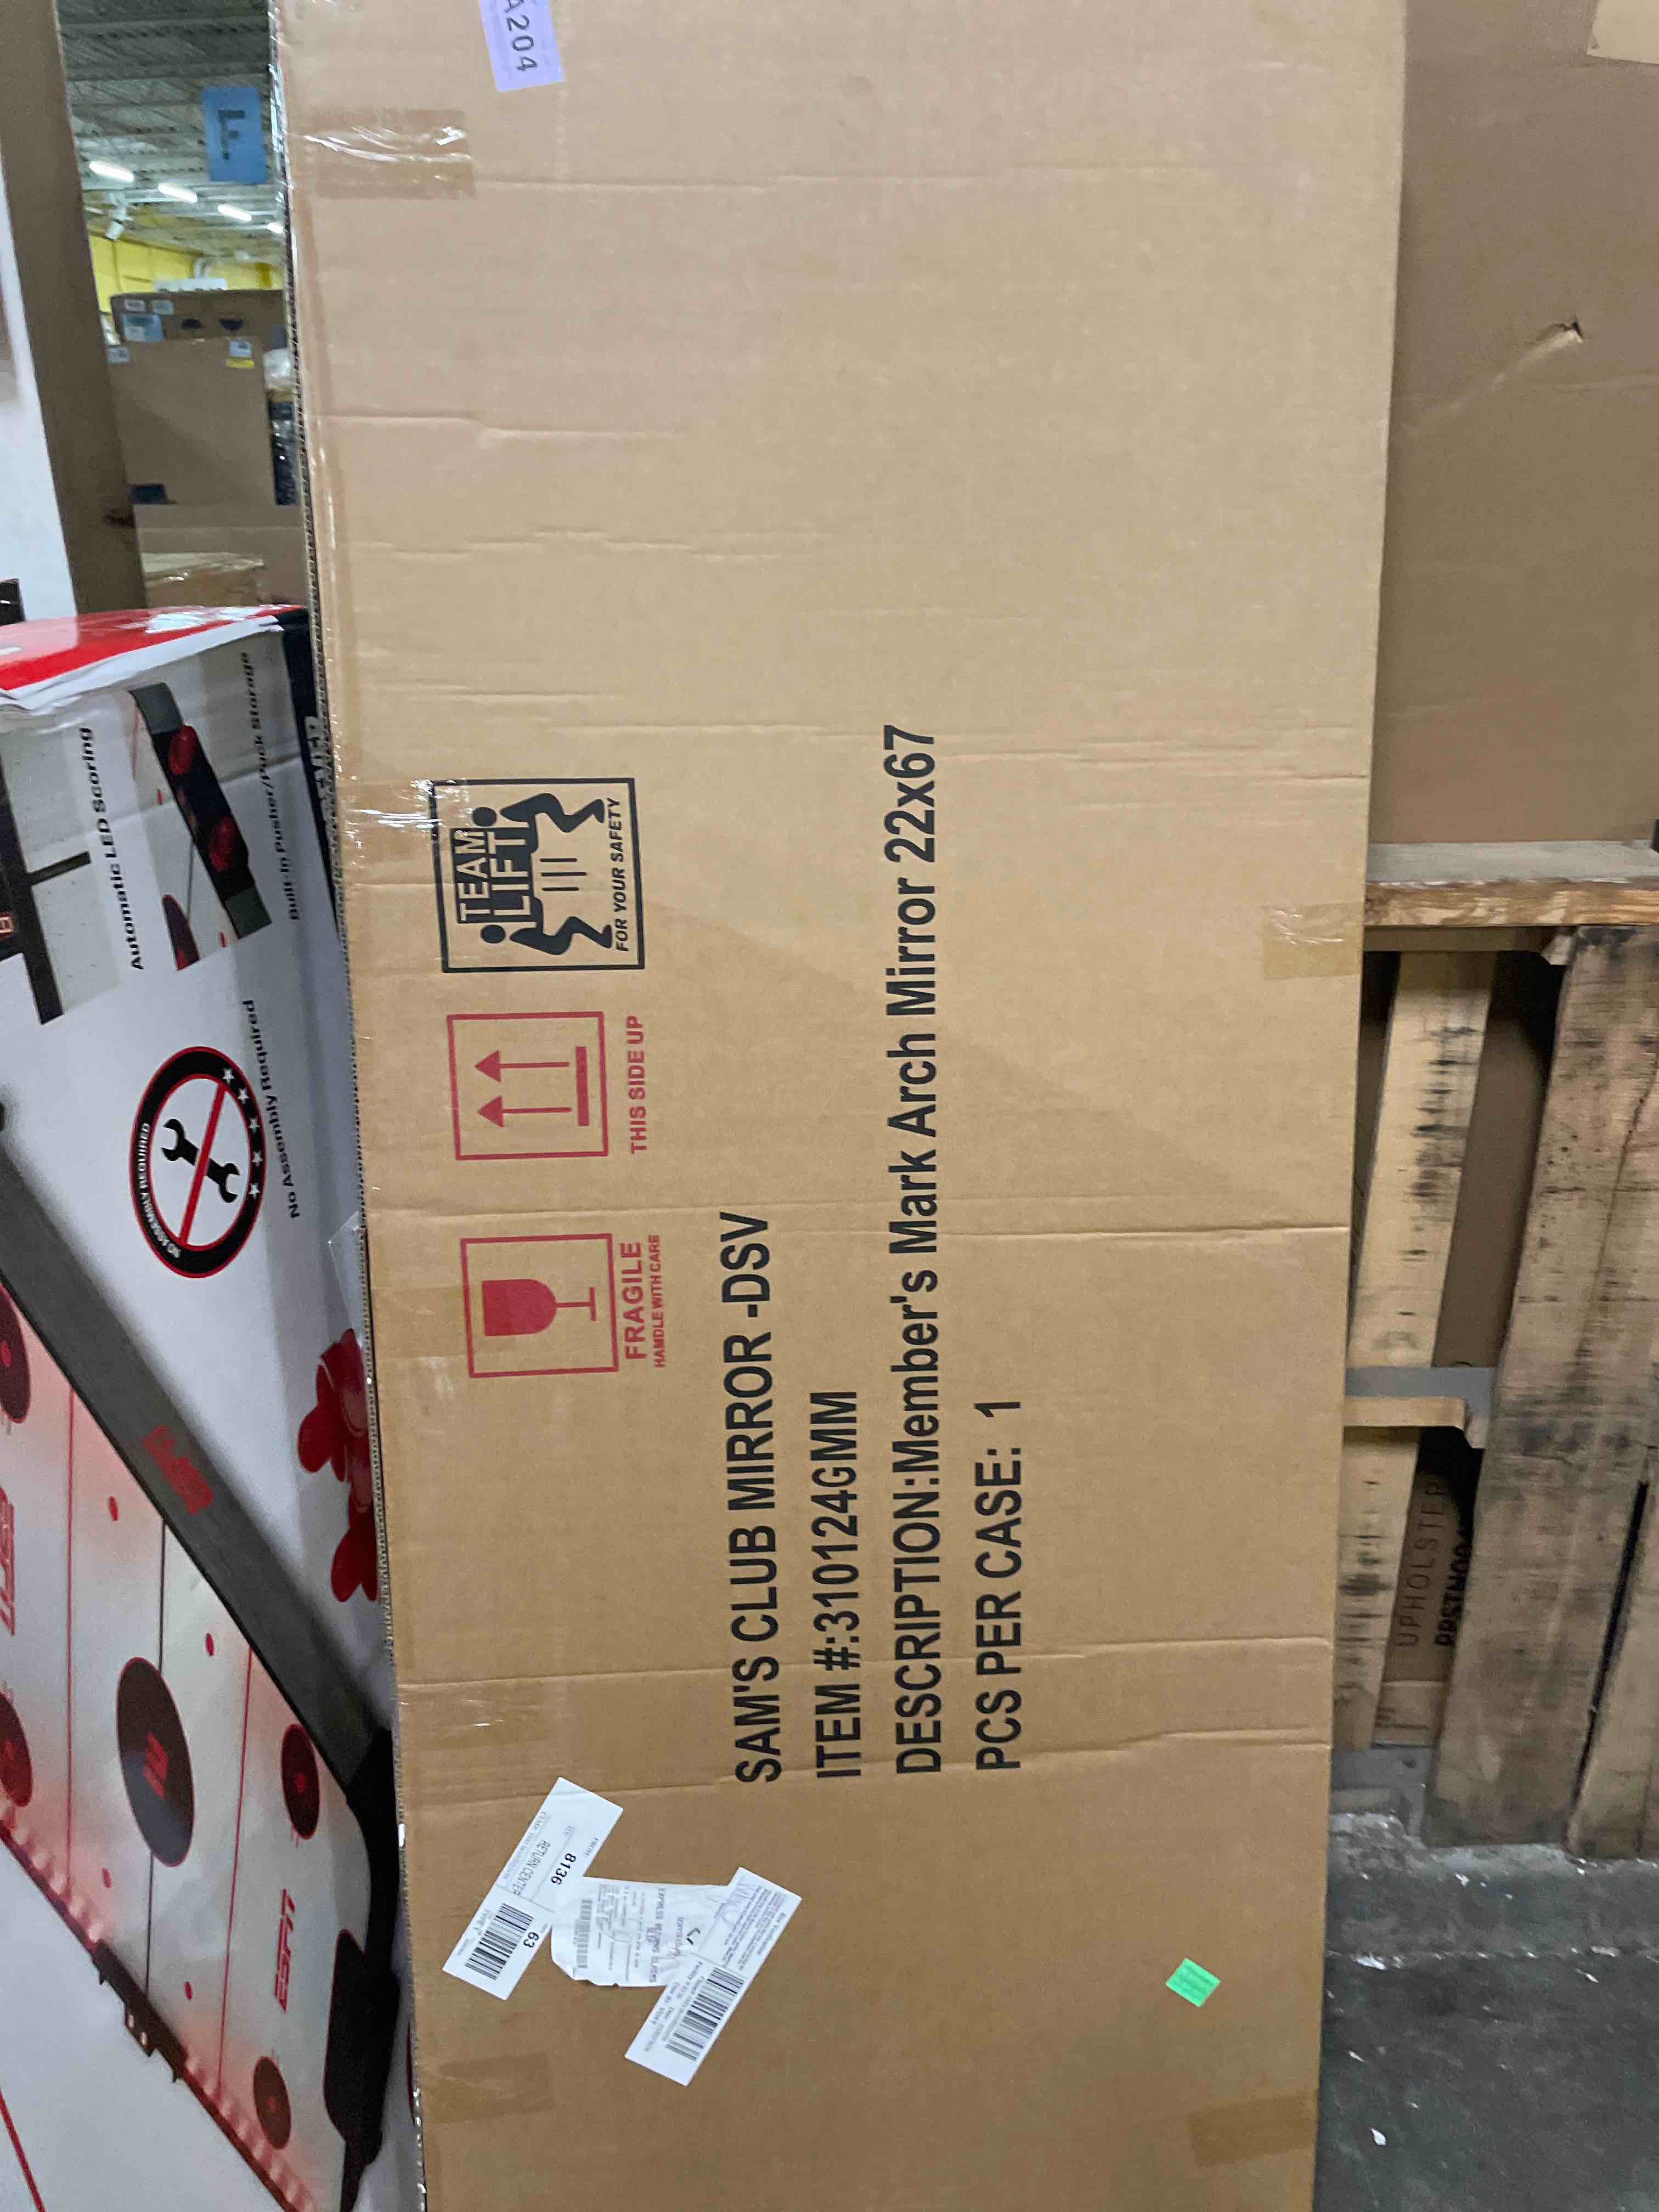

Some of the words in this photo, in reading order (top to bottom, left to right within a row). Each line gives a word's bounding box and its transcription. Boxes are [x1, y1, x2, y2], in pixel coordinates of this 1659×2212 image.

[218, 109, 246, 160] F
[240, 652, 264, 730] Storage
[80, 727, 106, 812] Scoring
[883, 725, 935, 863] 22x67
[99, 820, 117, 858] LED
[607, 797, 624, 863] SAFETY
[454, 831, 491, 922] TEAM
[488, 830, 531, 917] LIFT
[609, 866, 627, 913] YOUR
[109, 864, 144, 970] Automatic
[614, 919, 629, 952] FOR
[886, 877, 935, 1015] Mirror
[243, 1000, 271, 1090] Required
[625, 1014, 645, 1045] UP
[627, 1049, 646, 1099] SIDE
[887, 1033, 936, 1138] Arch
[266, 1094, 294, 1187] Assembly
[629, 1104, 648, 1154] THIS
[285, 1191, 301, 1218] No
[888, 1149, 938, 1254] Mark
[648, 1234, 661, 1273] CARE
[650, 1274, 663, 1310] WITH
[719, 1211, 770, 1318] -DSV
[620, 1242, 647, 1359] FRAGILE
[652, 1311, 665, 1368] HANDLE
[723, 1331, 775, 1511] MIRROR
[974, 1402, 1021, 1418] 1
[809, 1391, 861, 1671] #:310124GMM
[890, 1269, 942, 1774] DESCRIPTION:Member's
[974, 1448, 1022, 1578] CASE:
[728, 1525, 778, 1642] CLUB
[975, 1590, 1022, 1676] PER
[731, 1656, 782, 1783] SAM'S
[814, 1683, 862, 1779] ITEM
[975, 1689, 1022, 1770] PCS
[509, 1865, 534, 1896] CENTER
[525, 1838, 551, 1869] RETURN
[549, 1852, 577, 1886] 8136
[274, 1887, 295, 2013] ESPN
[522, 1930, 540, 1950] 63
